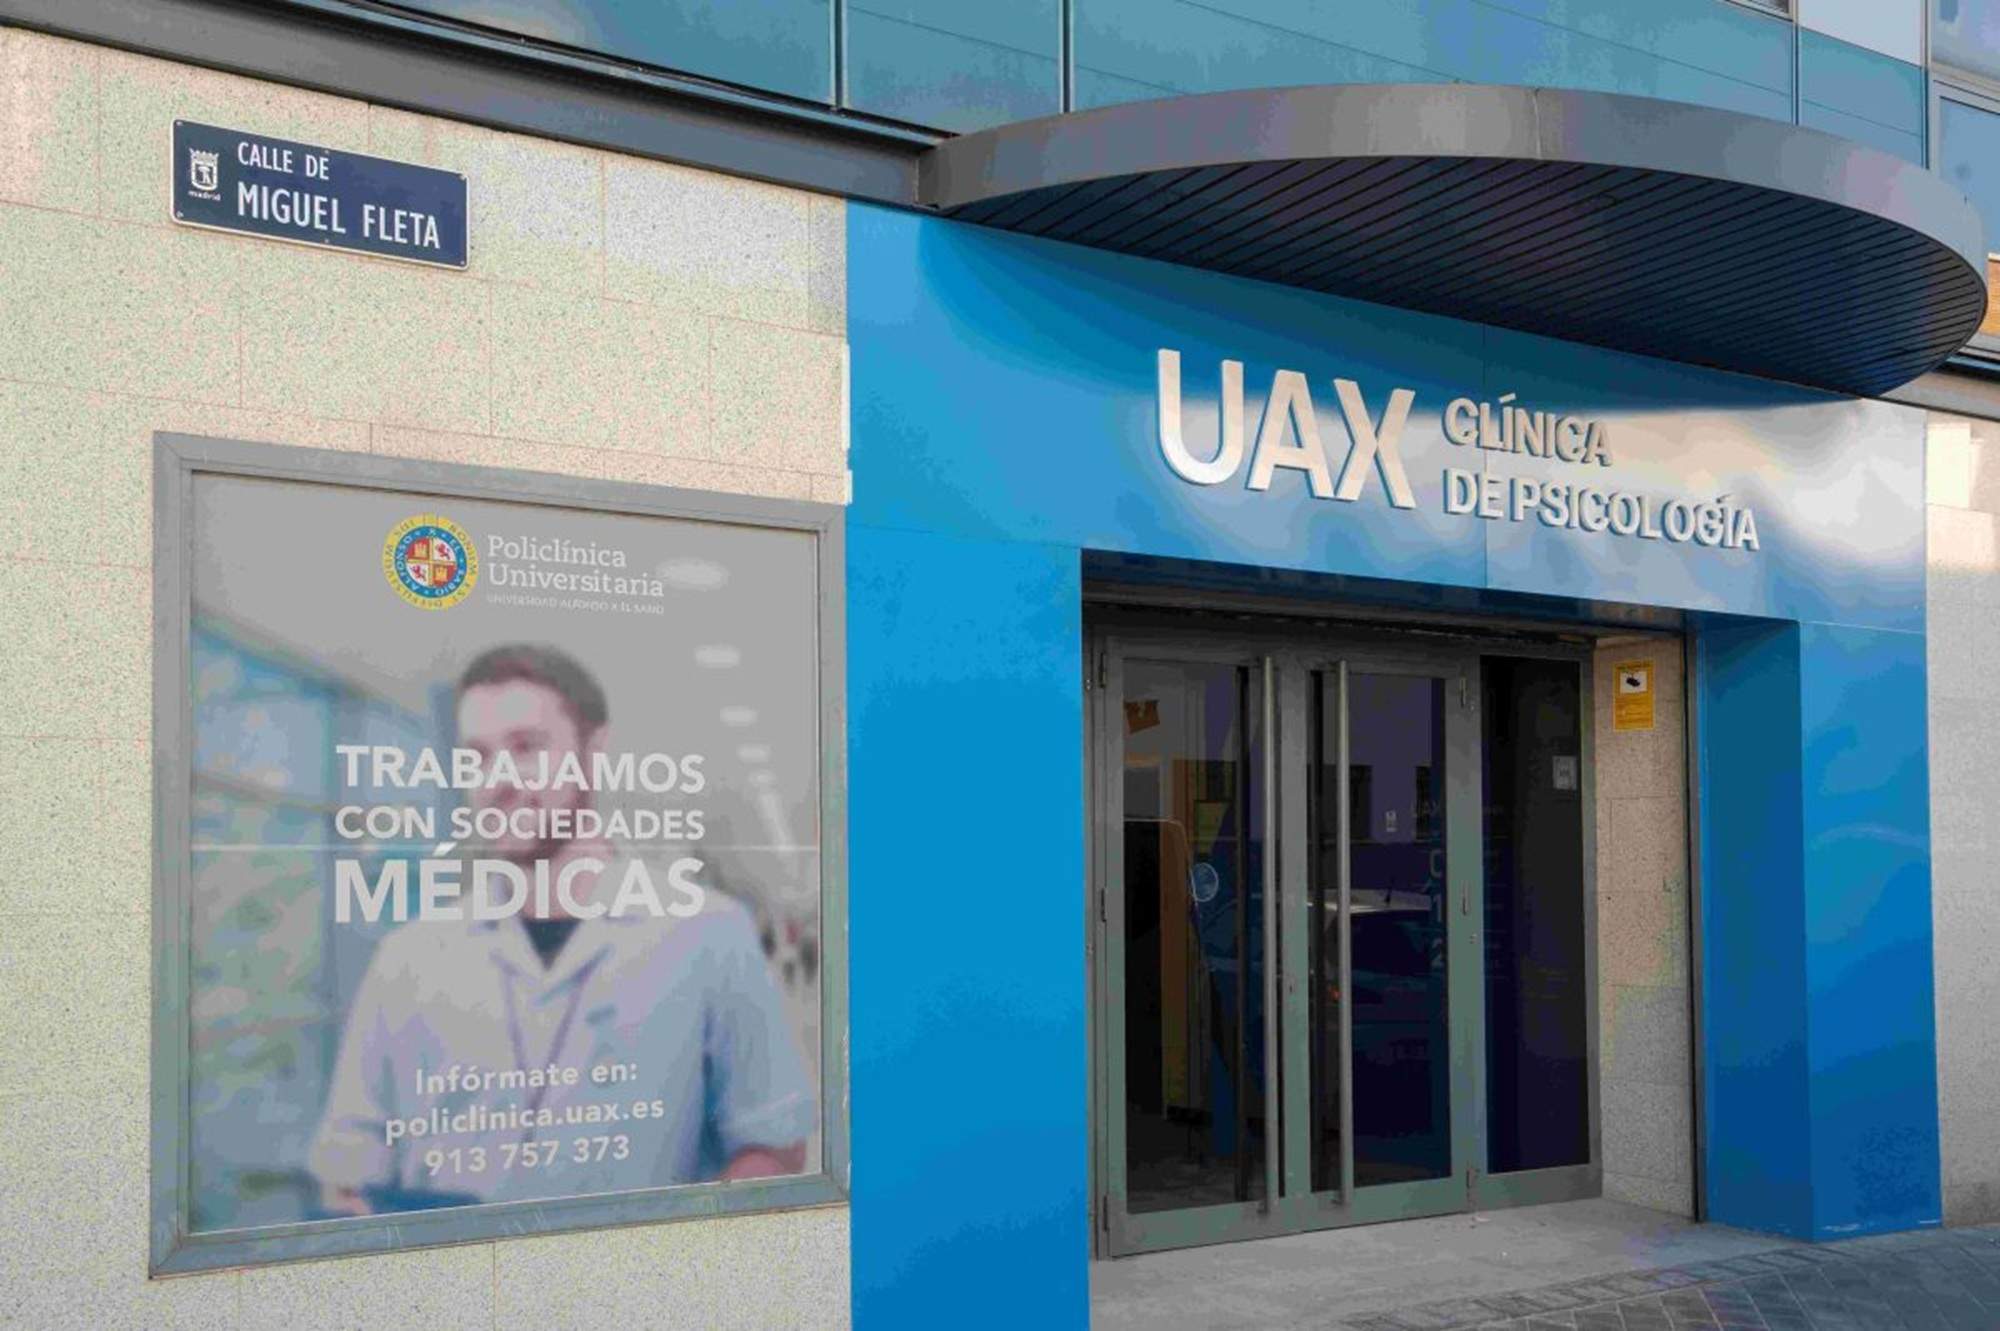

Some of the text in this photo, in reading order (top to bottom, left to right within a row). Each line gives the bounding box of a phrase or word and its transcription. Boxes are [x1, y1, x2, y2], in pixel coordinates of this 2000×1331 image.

[237, 142, 329, 180] CALLE DE
[238, 181, 440, 249] MIGUEL FLETA
[1157, 348, 1416, 508] UAX
[1443, 393, 1613, 466] CLÍNICA
[1444, 468, 1760, 550] DE PSICOLOGÍA
[487, 535, 626, 567] Policlínica
[488, 563, 664, 597] Universitaria
[336, 745, 706, 794] TRABAJAMOS
[335, 806, 705, 840] CON SOCIEDADES
[335, 842, 705, 923] MÉDICAS
[415, 1061, 638, 1096] Infórmate en:
[385, 1099, 664, 1146] policlinica.uax.es
[424, 1134, 630, 1176] 913 757 373
